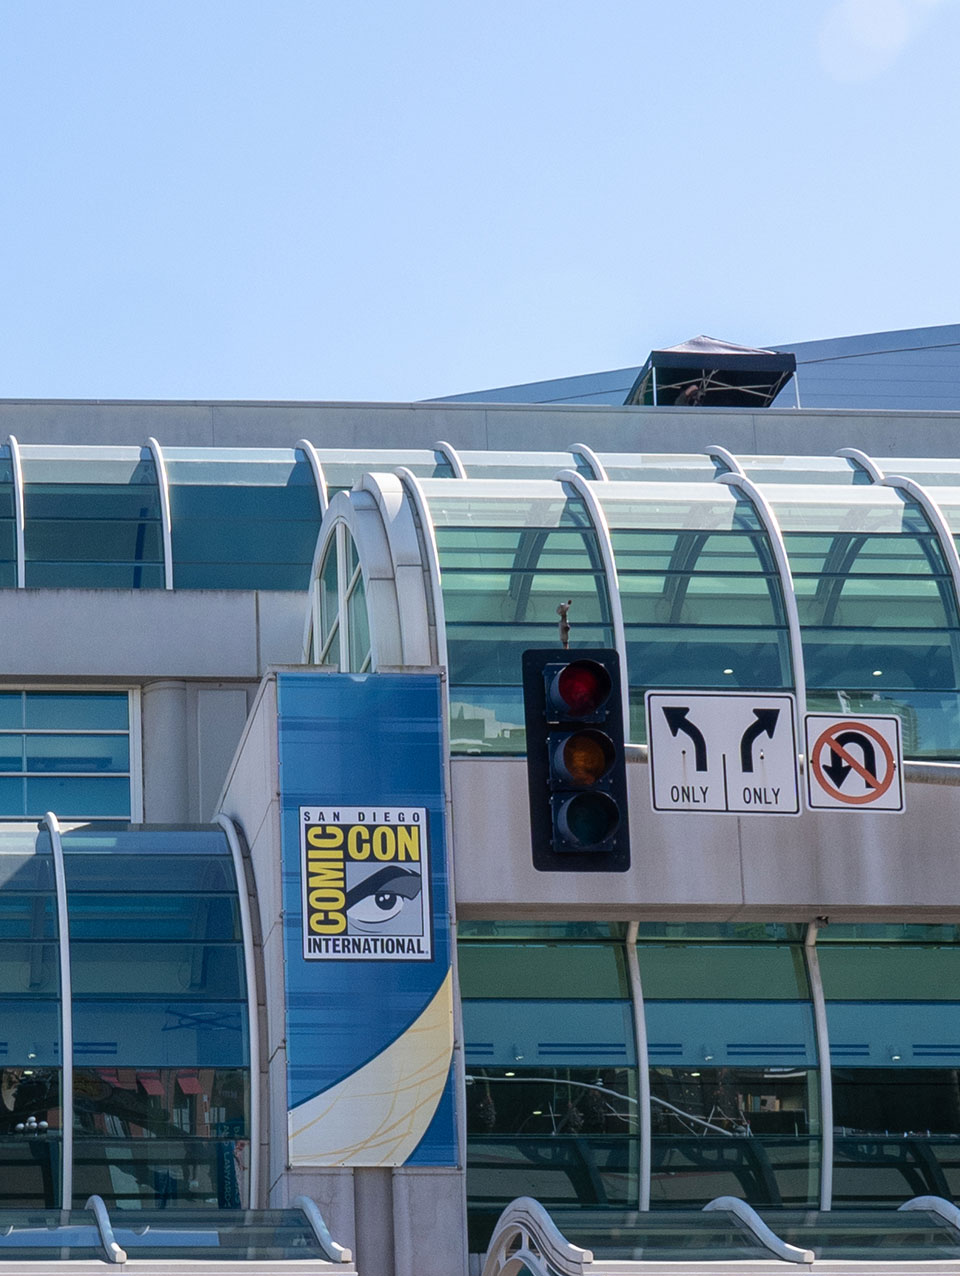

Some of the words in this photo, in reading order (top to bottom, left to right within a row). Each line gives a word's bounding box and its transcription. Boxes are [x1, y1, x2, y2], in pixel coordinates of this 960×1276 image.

[670, 785, 710, 803] ONLY
[742, 787, 781, 805] ONLY
[303, 811, 341, 822] SAN
[357, 811, 421, 823] DIEGO
[347, 825, 420, 862] CON
[307, 825, 347, 935] COMIC
[307, 937, 425, 954] INTERNATIONAL
